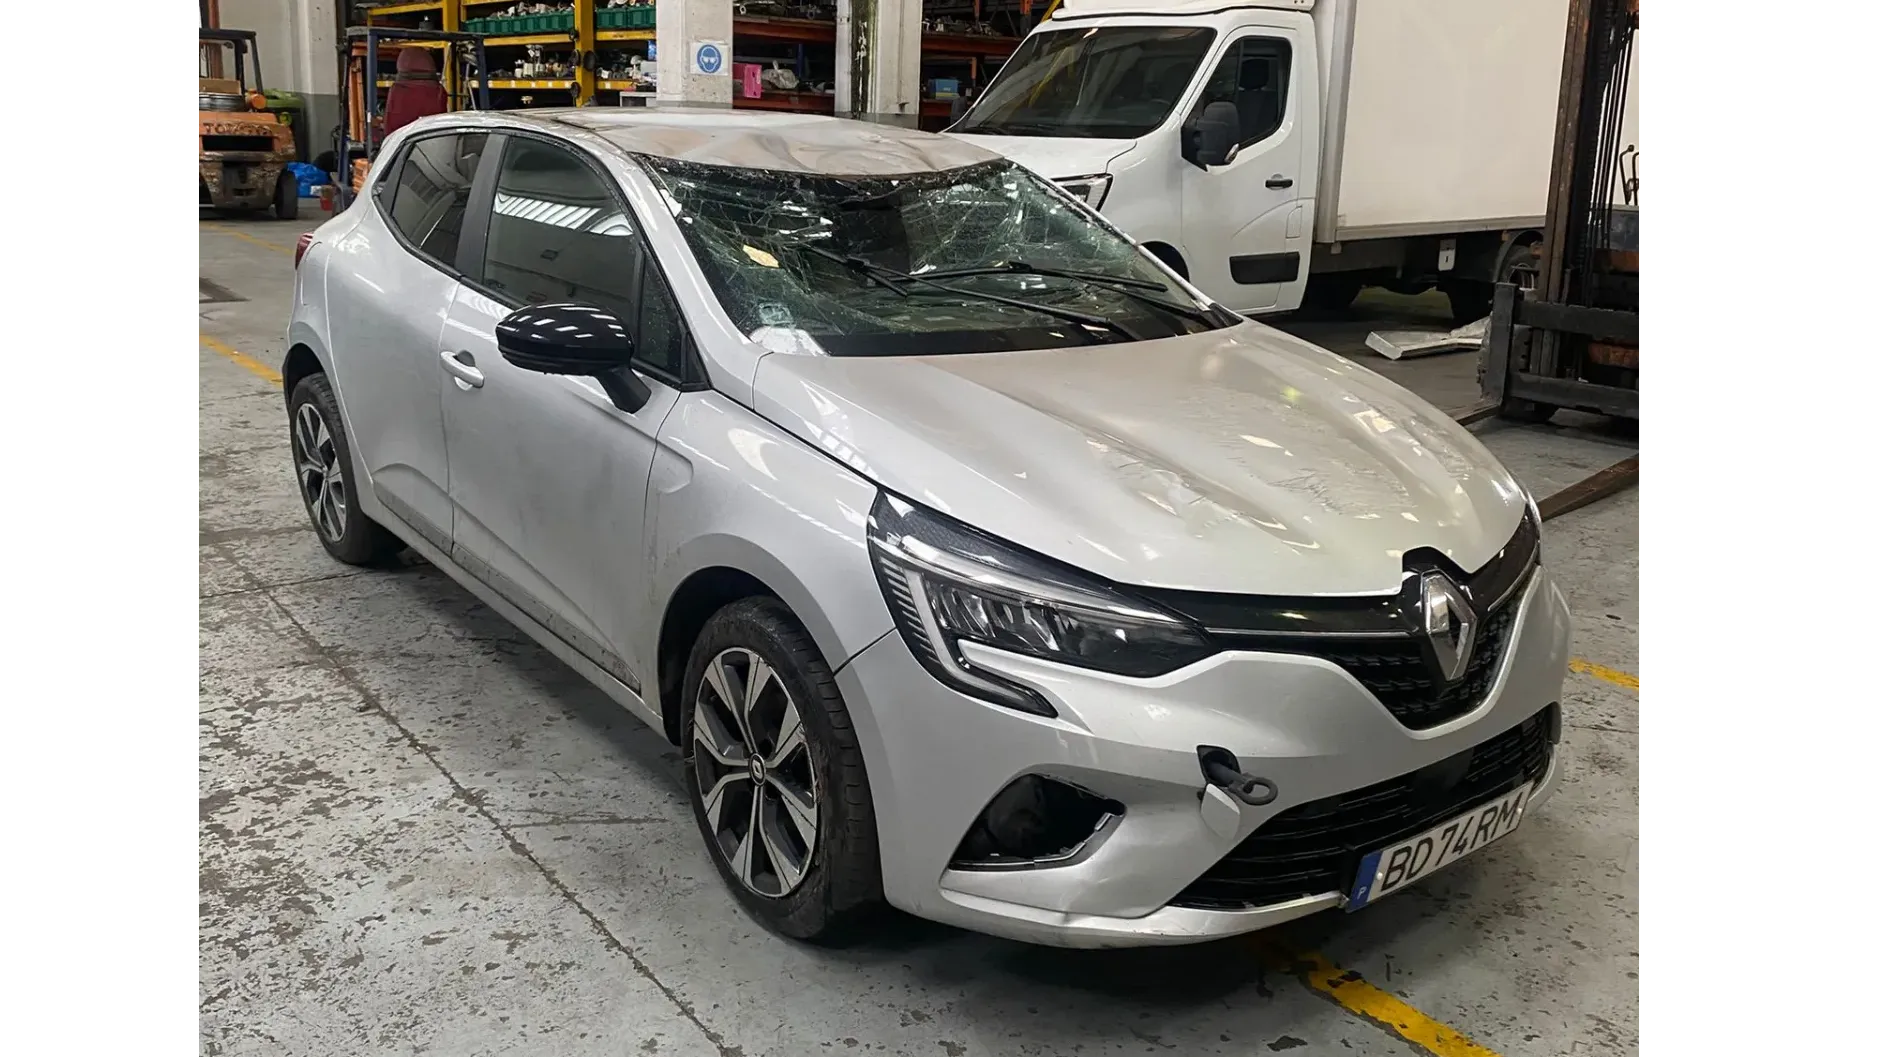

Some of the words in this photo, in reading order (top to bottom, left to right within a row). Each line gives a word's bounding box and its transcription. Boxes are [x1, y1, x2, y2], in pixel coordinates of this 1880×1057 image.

[1381, 837, 1433, 891] BD
[1435, 815, 1474, 866] 74
[1470, 791, 1523, 849] RM
[1356, 886, 1367, 900] P
